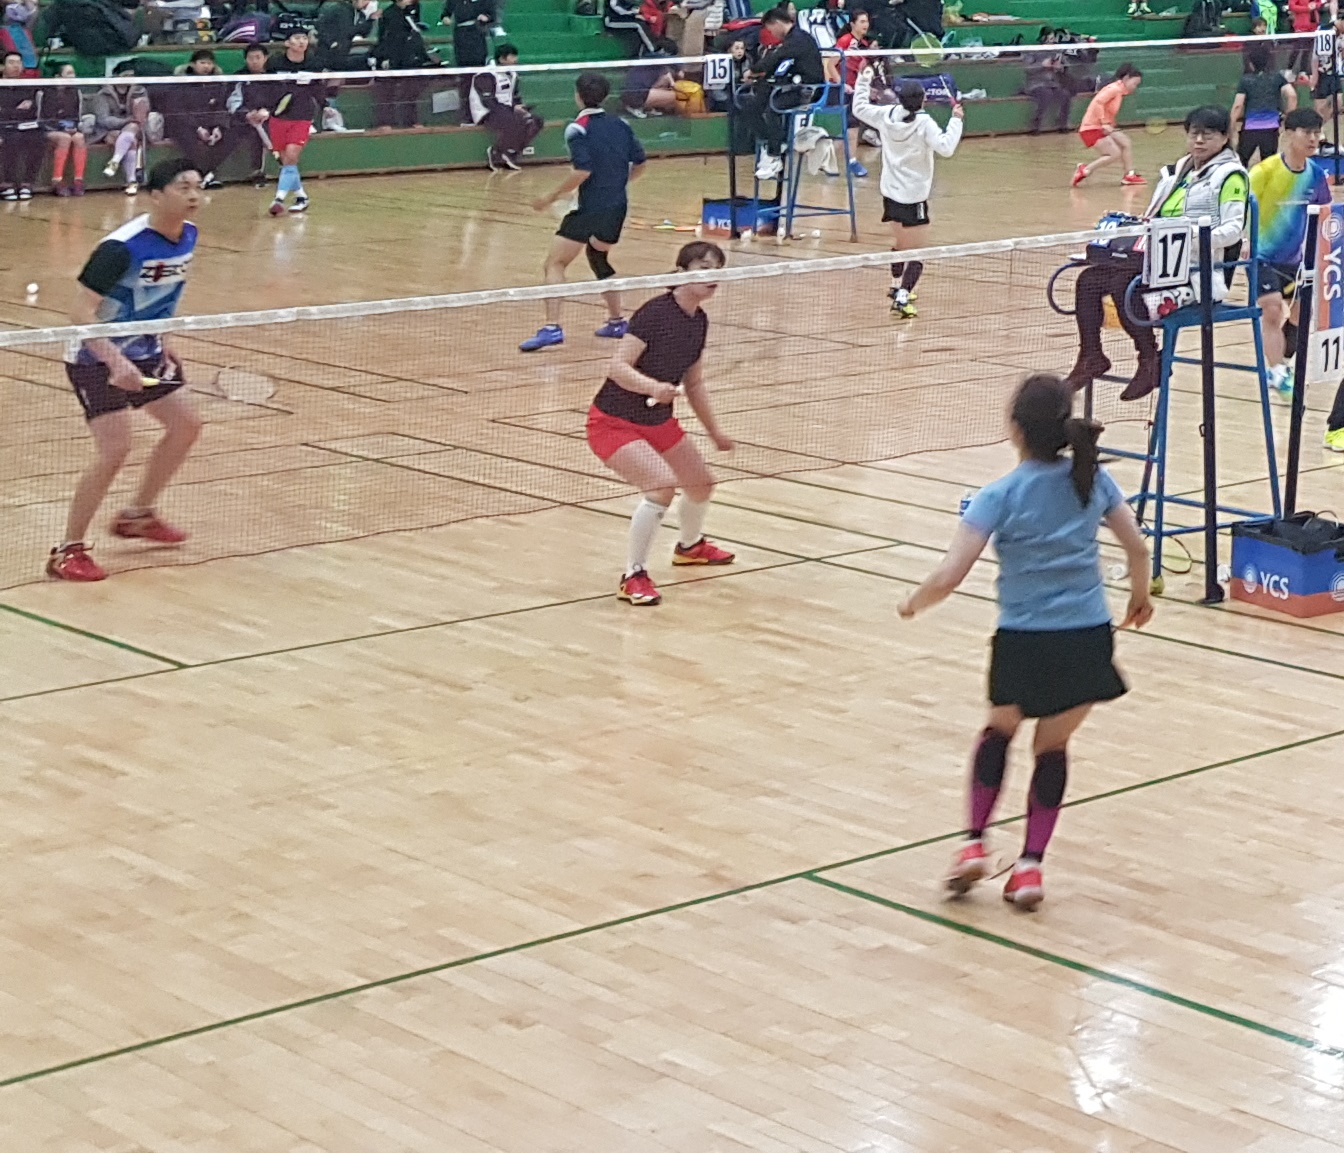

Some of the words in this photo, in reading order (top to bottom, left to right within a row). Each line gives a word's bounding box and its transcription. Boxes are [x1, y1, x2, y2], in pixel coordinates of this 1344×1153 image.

[1319, 33, 1332, 52] 18
[710, 58, 728, 80] 15
[925, 86, 953, 98] CTOR
[1158, 232, 1188, 279] 17
[1323, 246, 1342, 301] YCS
[1321, 336, 1341, 373] 11
[1260, 570, 1290, 601] YCS
